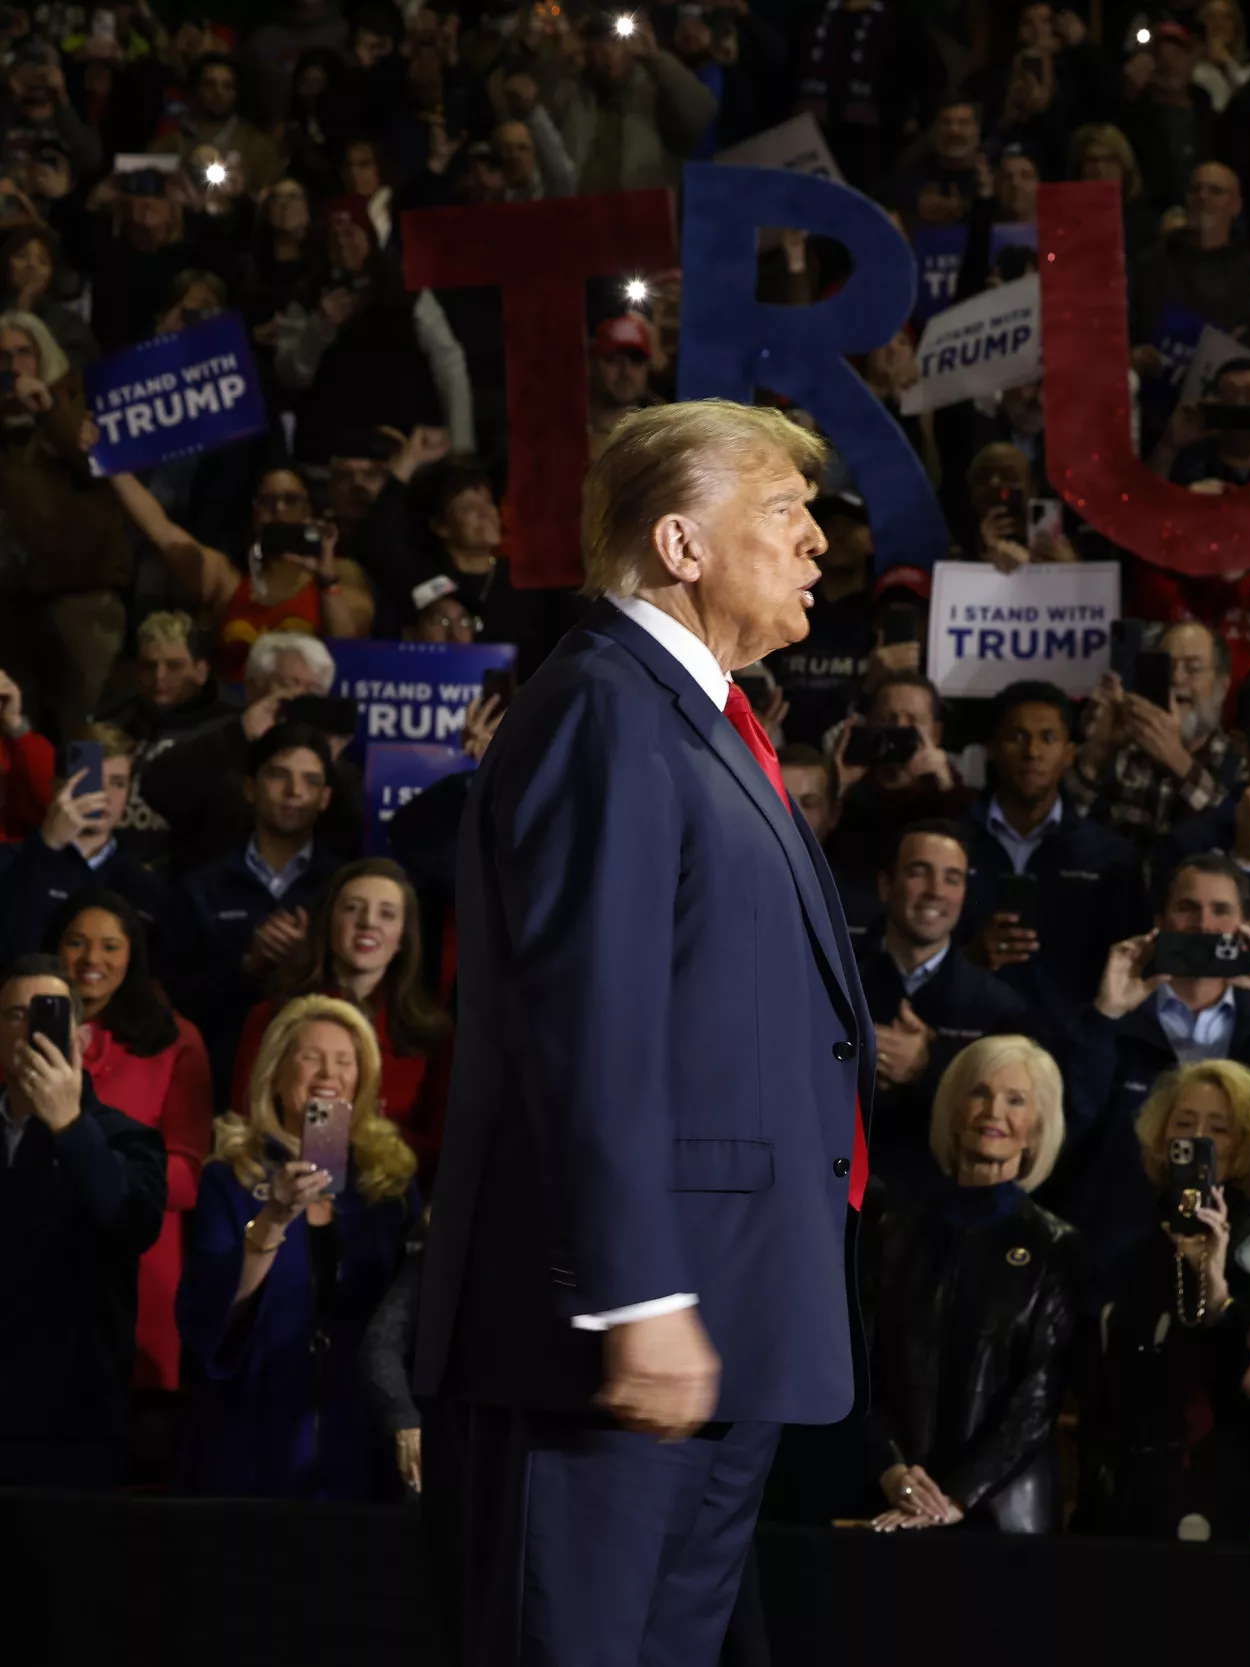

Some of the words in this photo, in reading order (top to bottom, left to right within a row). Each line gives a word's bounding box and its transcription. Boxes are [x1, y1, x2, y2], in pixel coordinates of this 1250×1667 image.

[922, 325, 1032, 378] TRUMP
[108, 373, 177, 406] STAND
[181, 353, 238, 383] WITH
[97, 374, 246, 444] TRUMP
[965, 606, 1039, 622] STAND
[1047, 605, 1104, 622] WITH
[948, 628, 1107, 660] TRUMP
[355, 680, 432, 700] STAND
[438, 683, 484, 702] WIT
[357, 702, 466, 740] RUM
